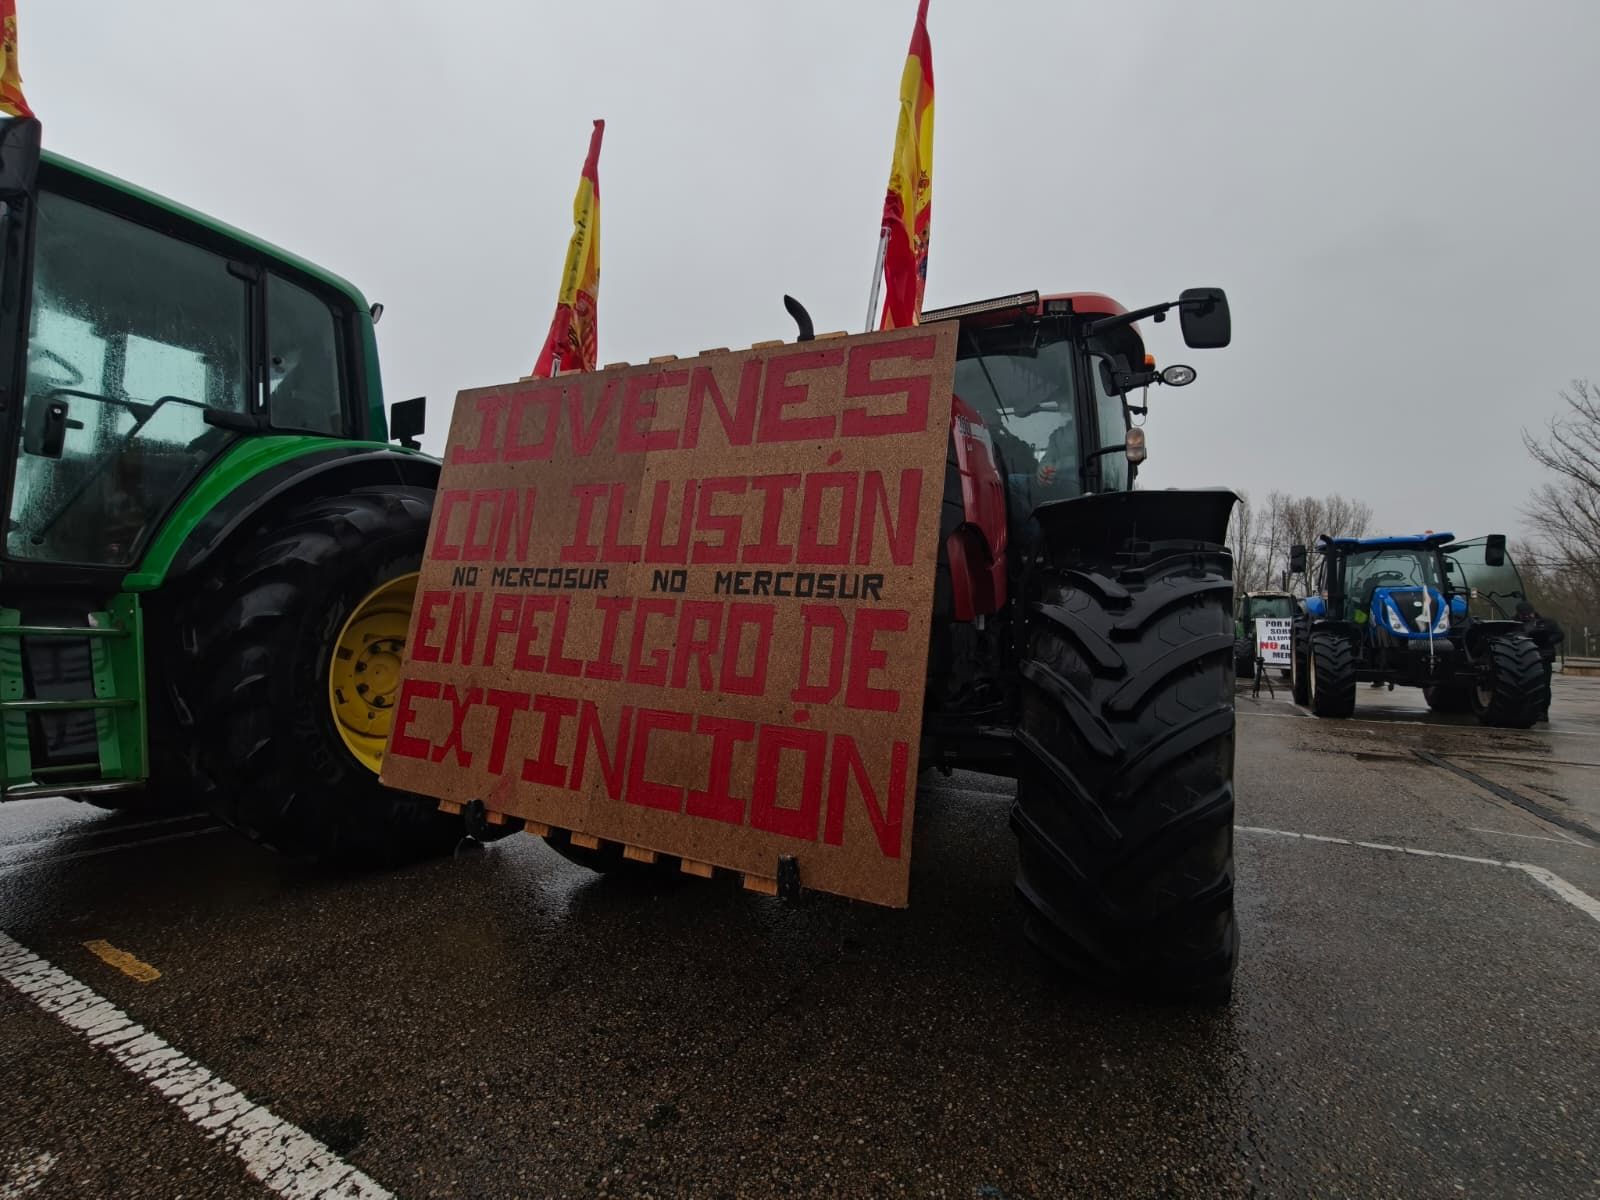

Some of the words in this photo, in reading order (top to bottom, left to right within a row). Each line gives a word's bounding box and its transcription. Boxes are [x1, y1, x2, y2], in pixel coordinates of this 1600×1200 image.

[452, 335, 936, 465] JOVENES
[431, 488, 536, 562] CON
[560, 450, 923, 566] ILUSIÓN
[451, 566, 479, 587] NO
[491, 566, 609, 590] MERCOSUR
[651, 569, 688, 594] NO
[714, 570, 885, 601] MERCOSUR
[411, 591, 483, 666] EN
[483, 594, 776, 697] PELIGRO
[791, 604, 910, 712] DE
[1260, 641, 1278, 649] NO
[391, 678, 909, 859] EXTINCIÓN
